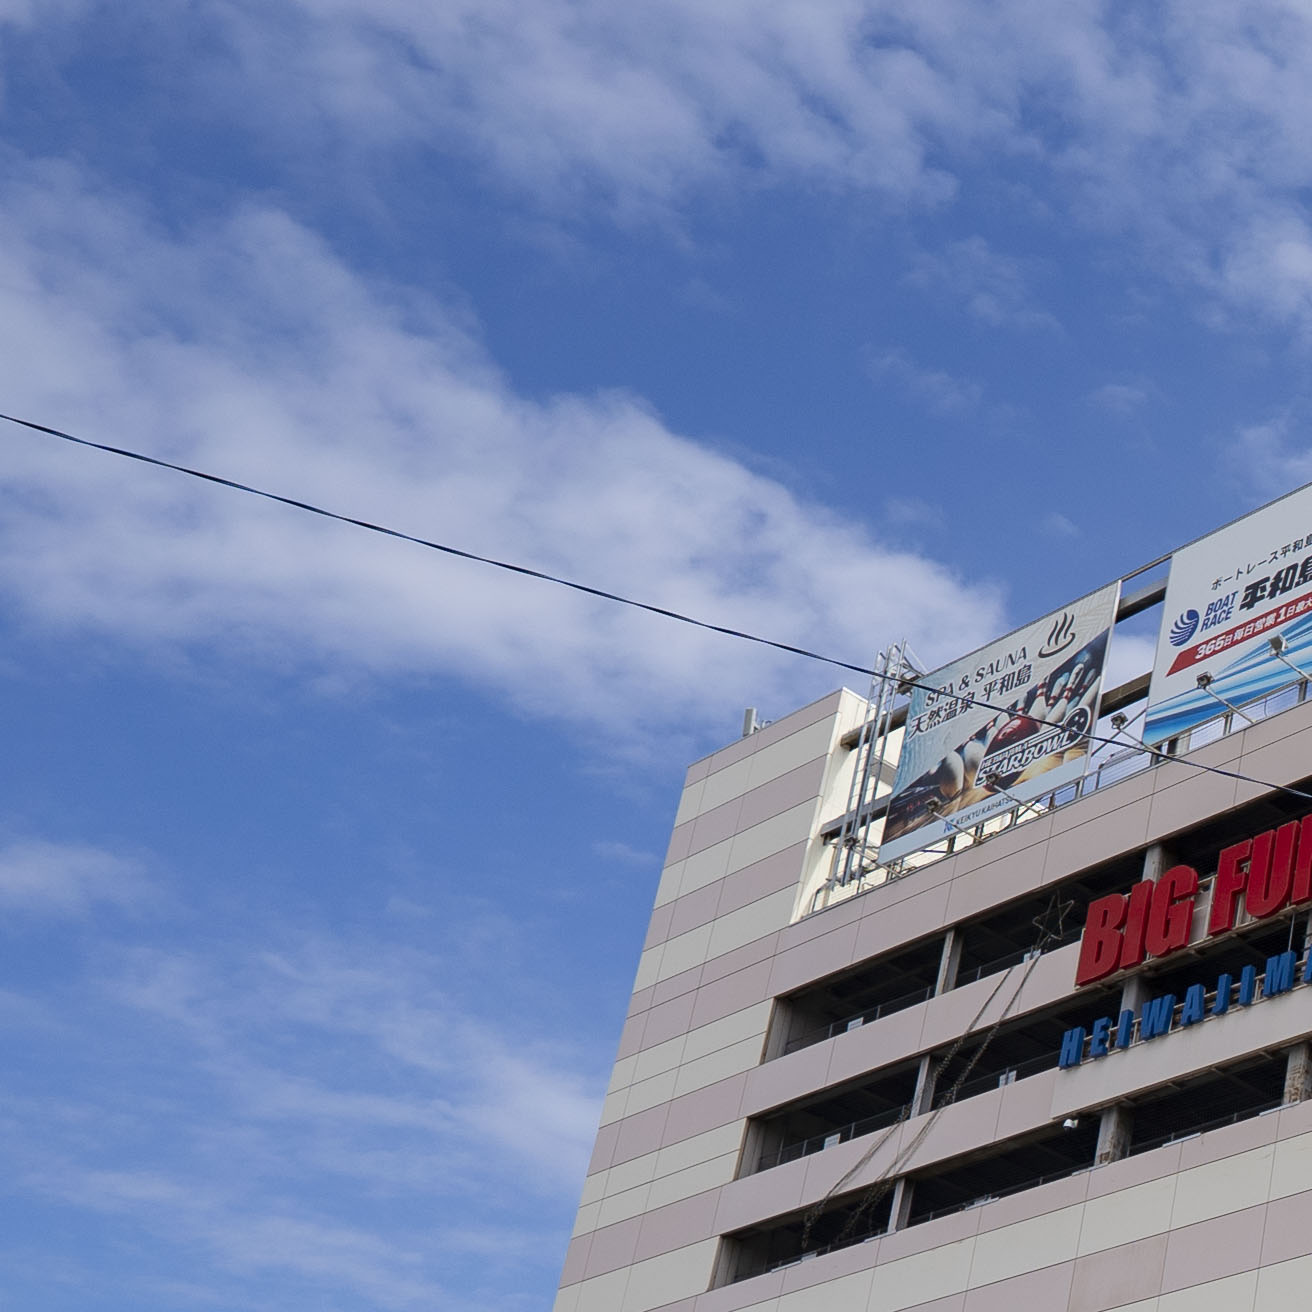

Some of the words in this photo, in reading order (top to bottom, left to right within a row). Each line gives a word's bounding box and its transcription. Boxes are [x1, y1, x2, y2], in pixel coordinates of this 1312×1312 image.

[1201, 608, 1232, 632] RACE
[1205, 591, 1238, 615] BOAT
[908, 691, 975, 742] 天然温泉
[983, 663, 1033, 702] 平和島
[925, 682, 955, 707] SPA
[958, 673, 970, 692] &
[975, 647, 1027, 683] SAUNA
[976, 733, 1072, 785] STARBOWL
[1075, 866, 1198, 986] BIG
